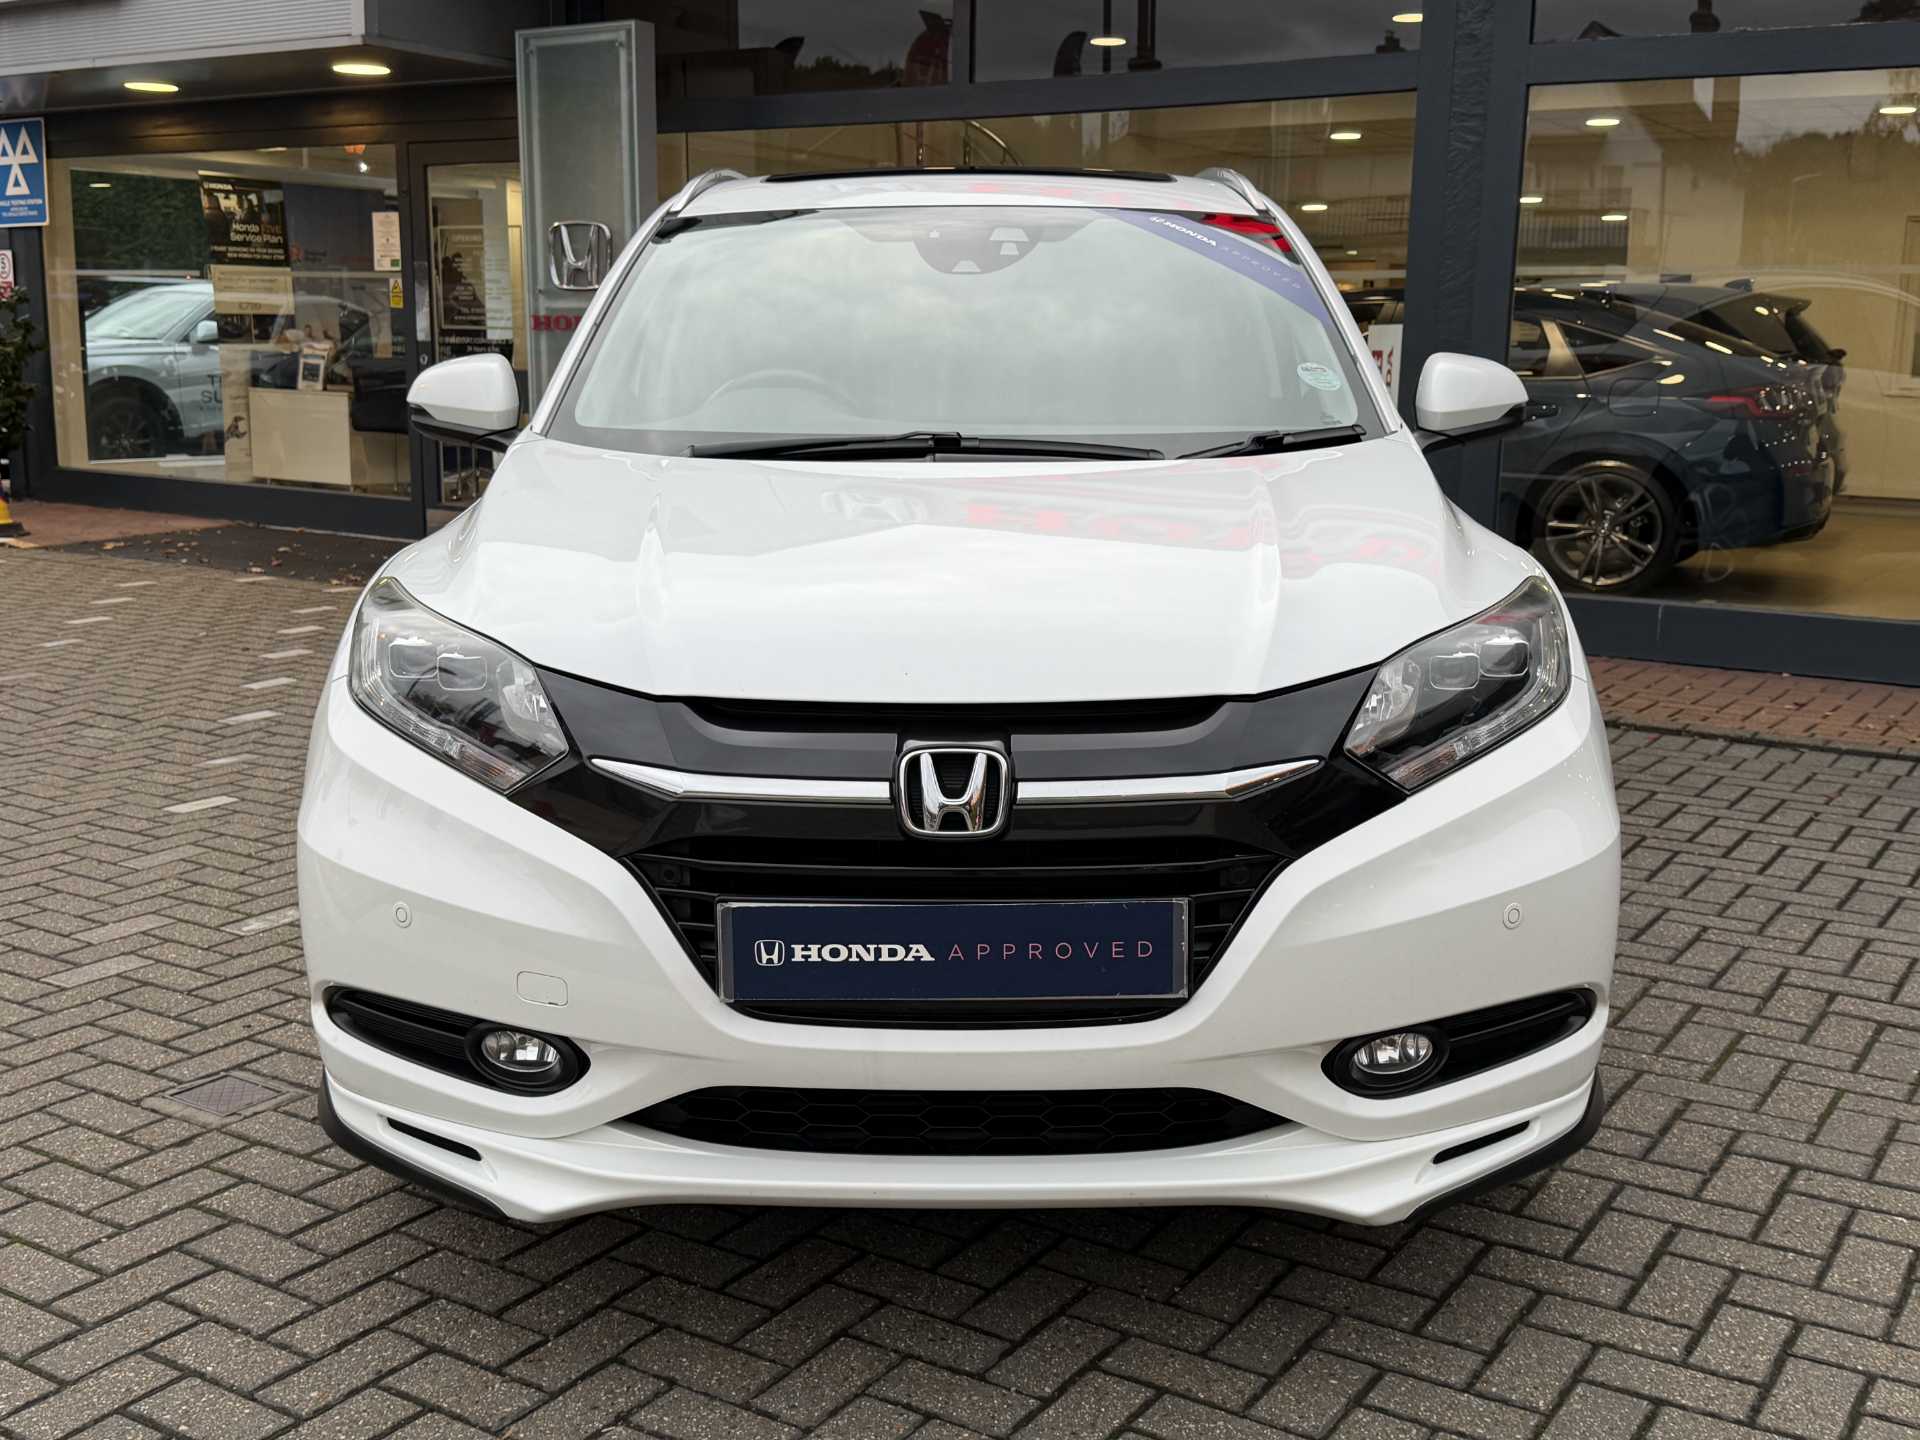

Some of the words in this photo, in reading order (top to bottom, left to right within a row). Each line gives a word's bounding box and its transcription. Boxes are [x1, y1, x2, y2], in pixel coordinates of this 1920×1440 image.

[232, 221, 260, 233] Honda
[1163, 221, 1217, 247] HONDA
[230, 231, 262, 242] Service
[263, 233, 284, 244] Plan
[790, 943, 935, 962] HONDA
[948, 940, 1153, 961] APPROVED
